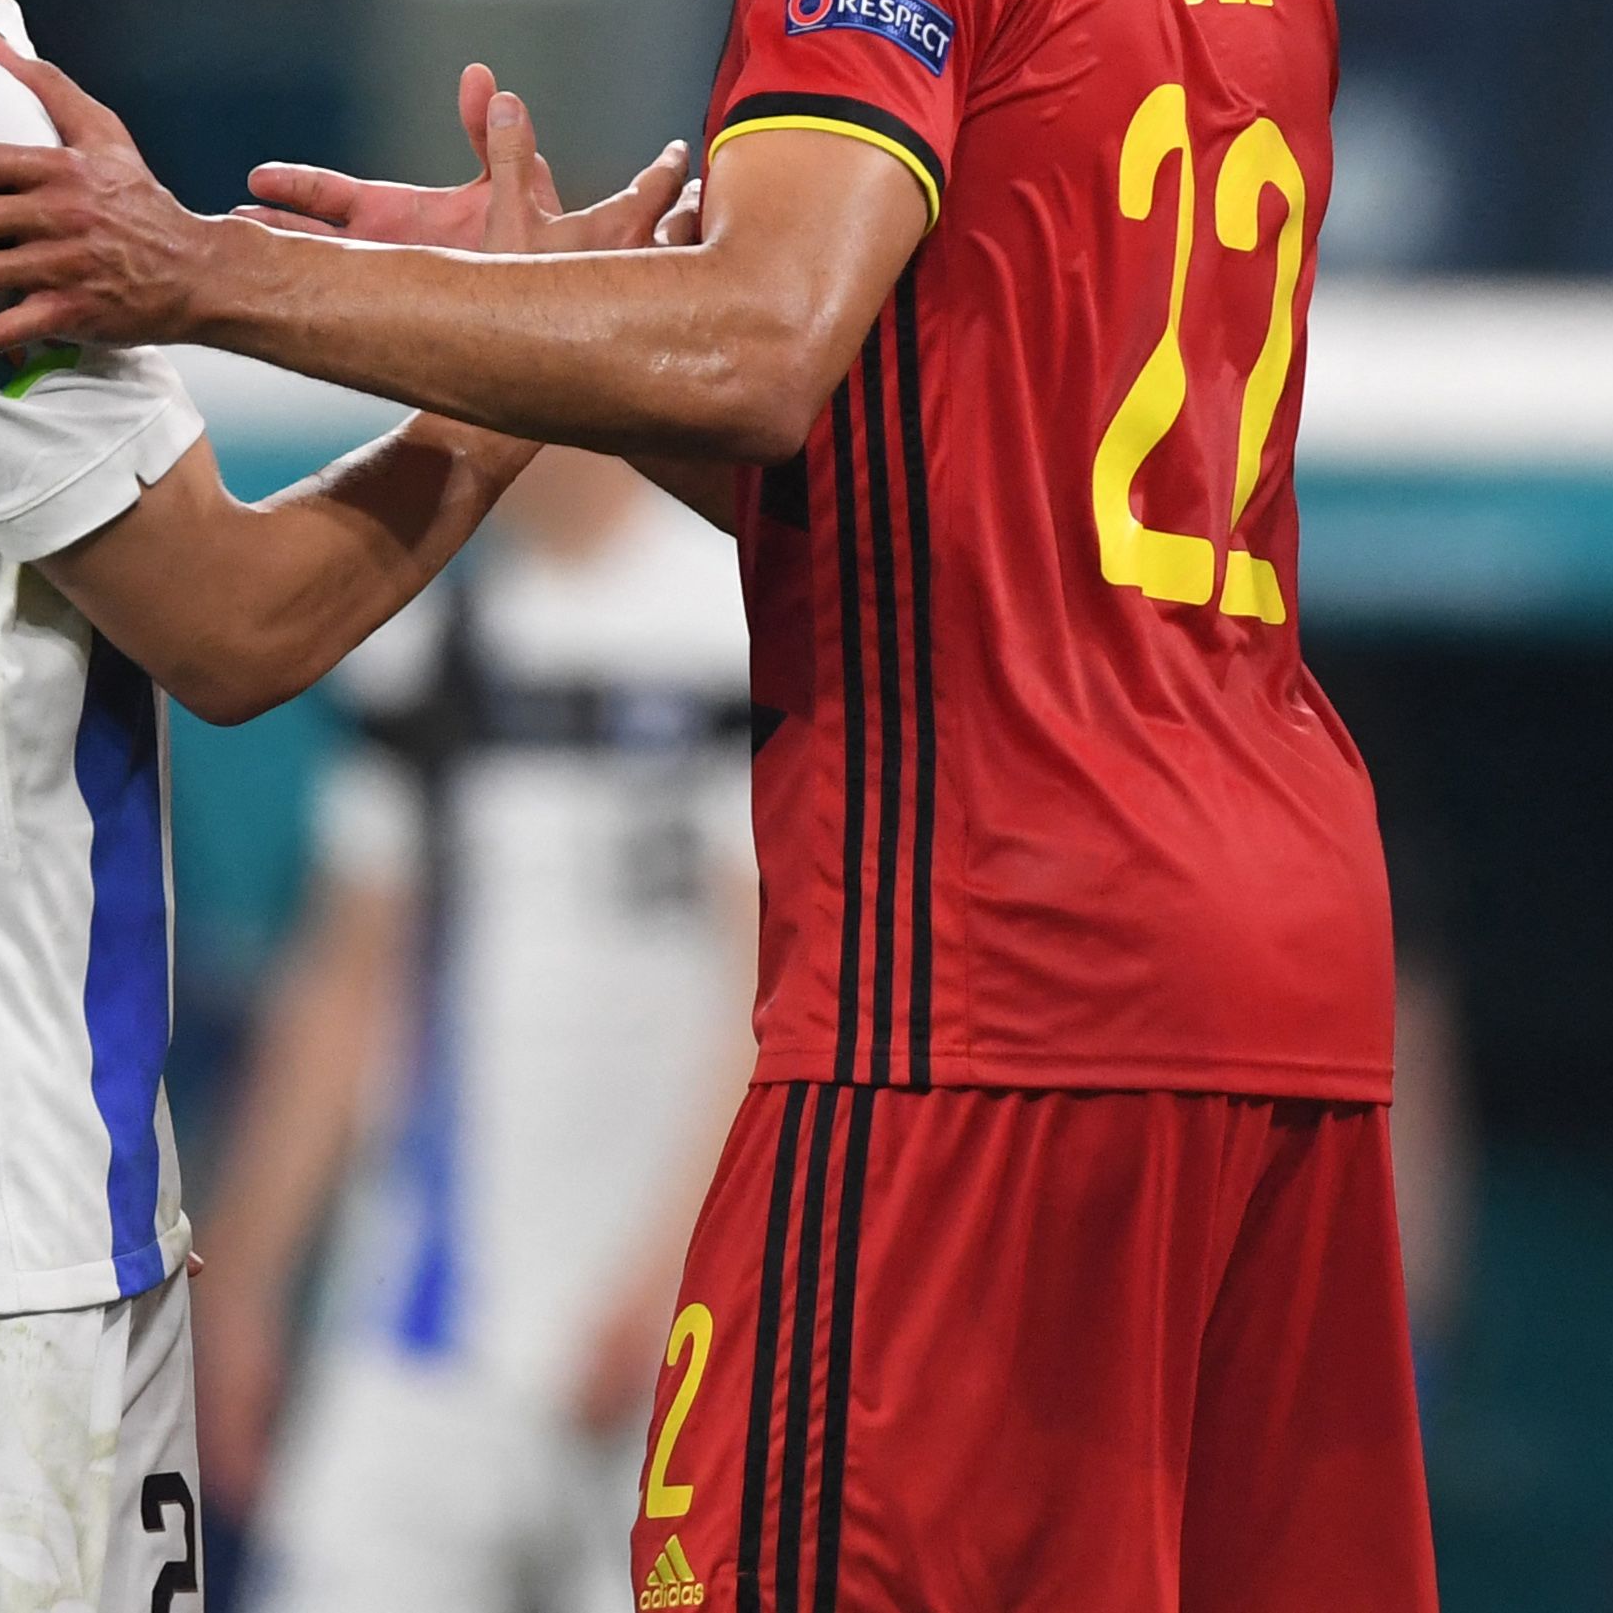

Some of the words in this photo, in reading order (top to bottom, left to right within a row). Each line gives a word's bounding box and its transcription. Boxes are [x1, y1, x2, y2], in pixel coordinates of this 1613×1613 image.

[1092, 83, 1305, 624] 22
[645, 1301, 714, 1519] 2
[639, 1581, 705, 1612] adidas
